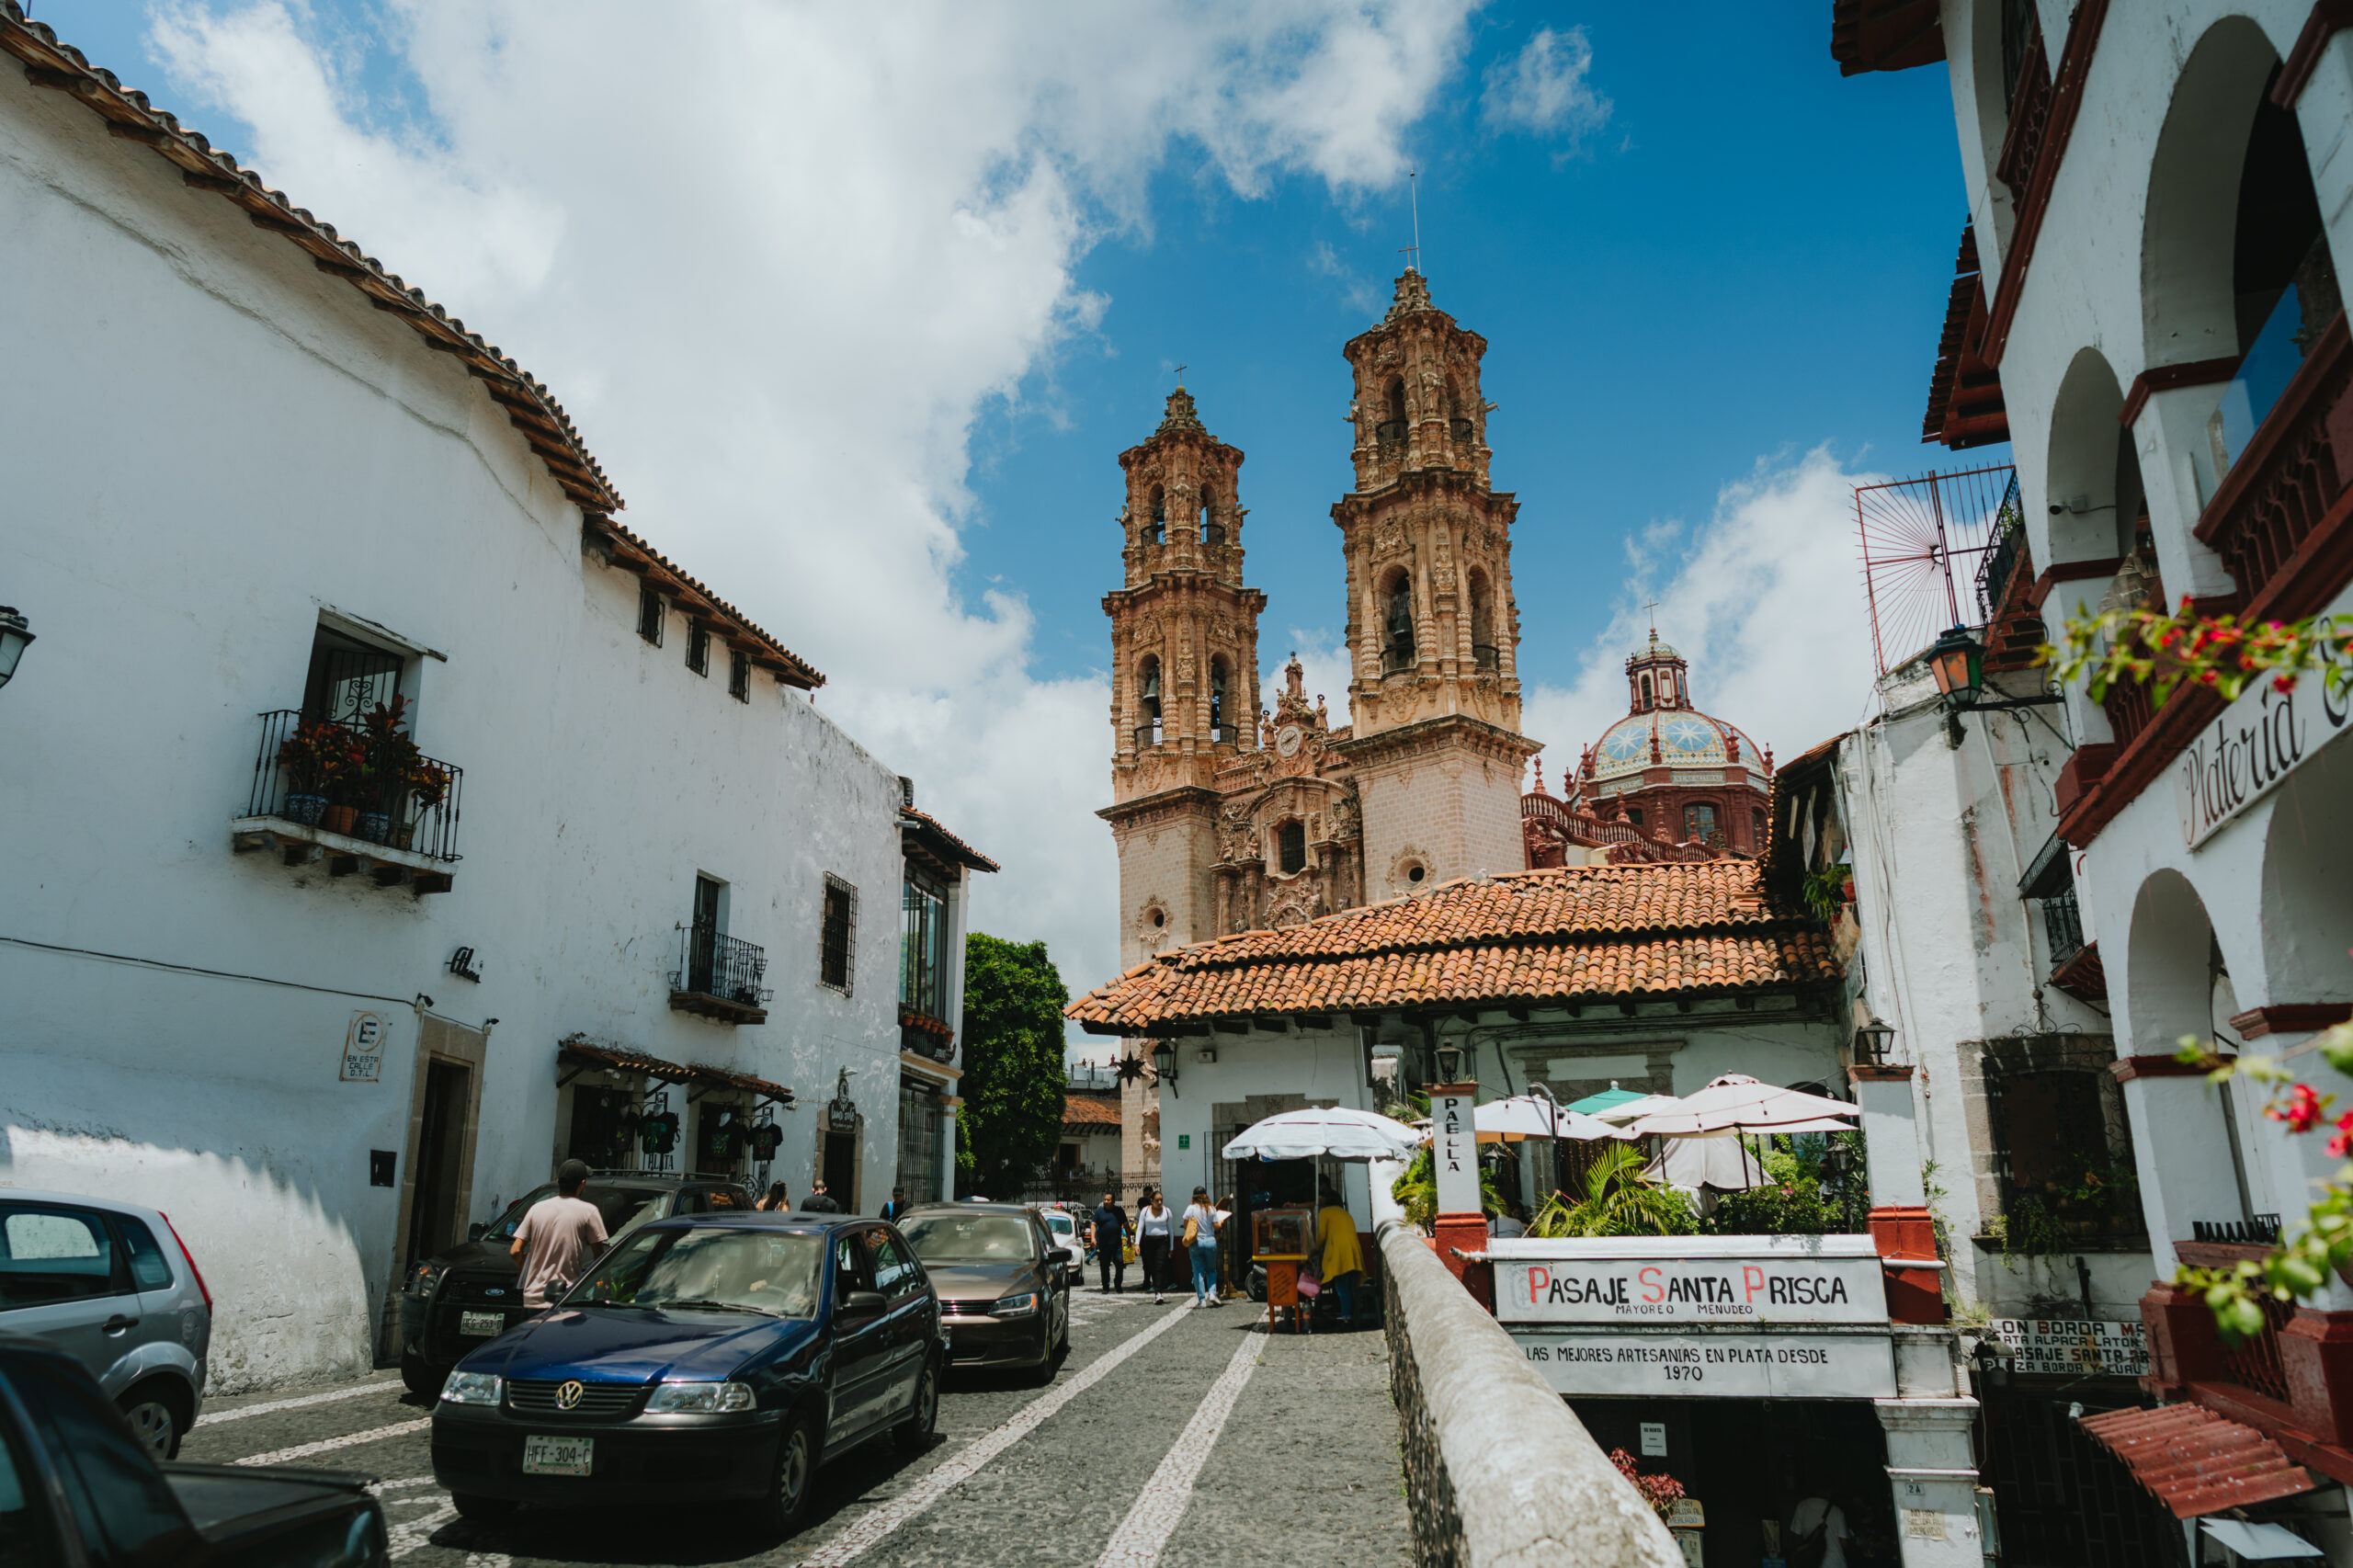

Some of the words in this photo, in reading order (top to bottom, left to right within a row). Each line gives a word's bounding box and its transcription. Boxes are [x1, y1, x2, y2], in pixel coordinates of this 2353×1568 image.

[358, 1022, 377, 1043] E
[347, 1054, 357, 1062] EN
[359, 1055, 379, 1063] ESTA
[348, 1062, 374, 1071] CALLE
[1445, 1098, 1460, 1172] PAELLA
[1529, 1267, 1630, 1306] PASAJE
[1638, 1267, 1734, 1303] SANTA
[1743, 1266, 1847, 1305] PRISCA
[1616, 1304, 1674, 1314] MAYOREO
[1698, 1304, 1753, 1315] MENUDEO
[2037, 1322, 2106, 1335] BORDA
[2034, 1335, 2088, 1346] ALPACA
[1526, 1346, 1549, 1361] LAS
[1557, 1347, 1612, 1362] MEJORES
[1617, 1347, 1700, 1362] ARTESANIAS
[1706, 1348, 1724, 1363] EN
[1729, 1348, 1774, 1363] PLATA
[1778, 1348, 1828, 1364] DESDE
[2071, 1348, 2123, 1362] SANTA
[1664, 1366, 1703, 1381] 1970
[2042, 1362, 2084, 1373] BORDA
